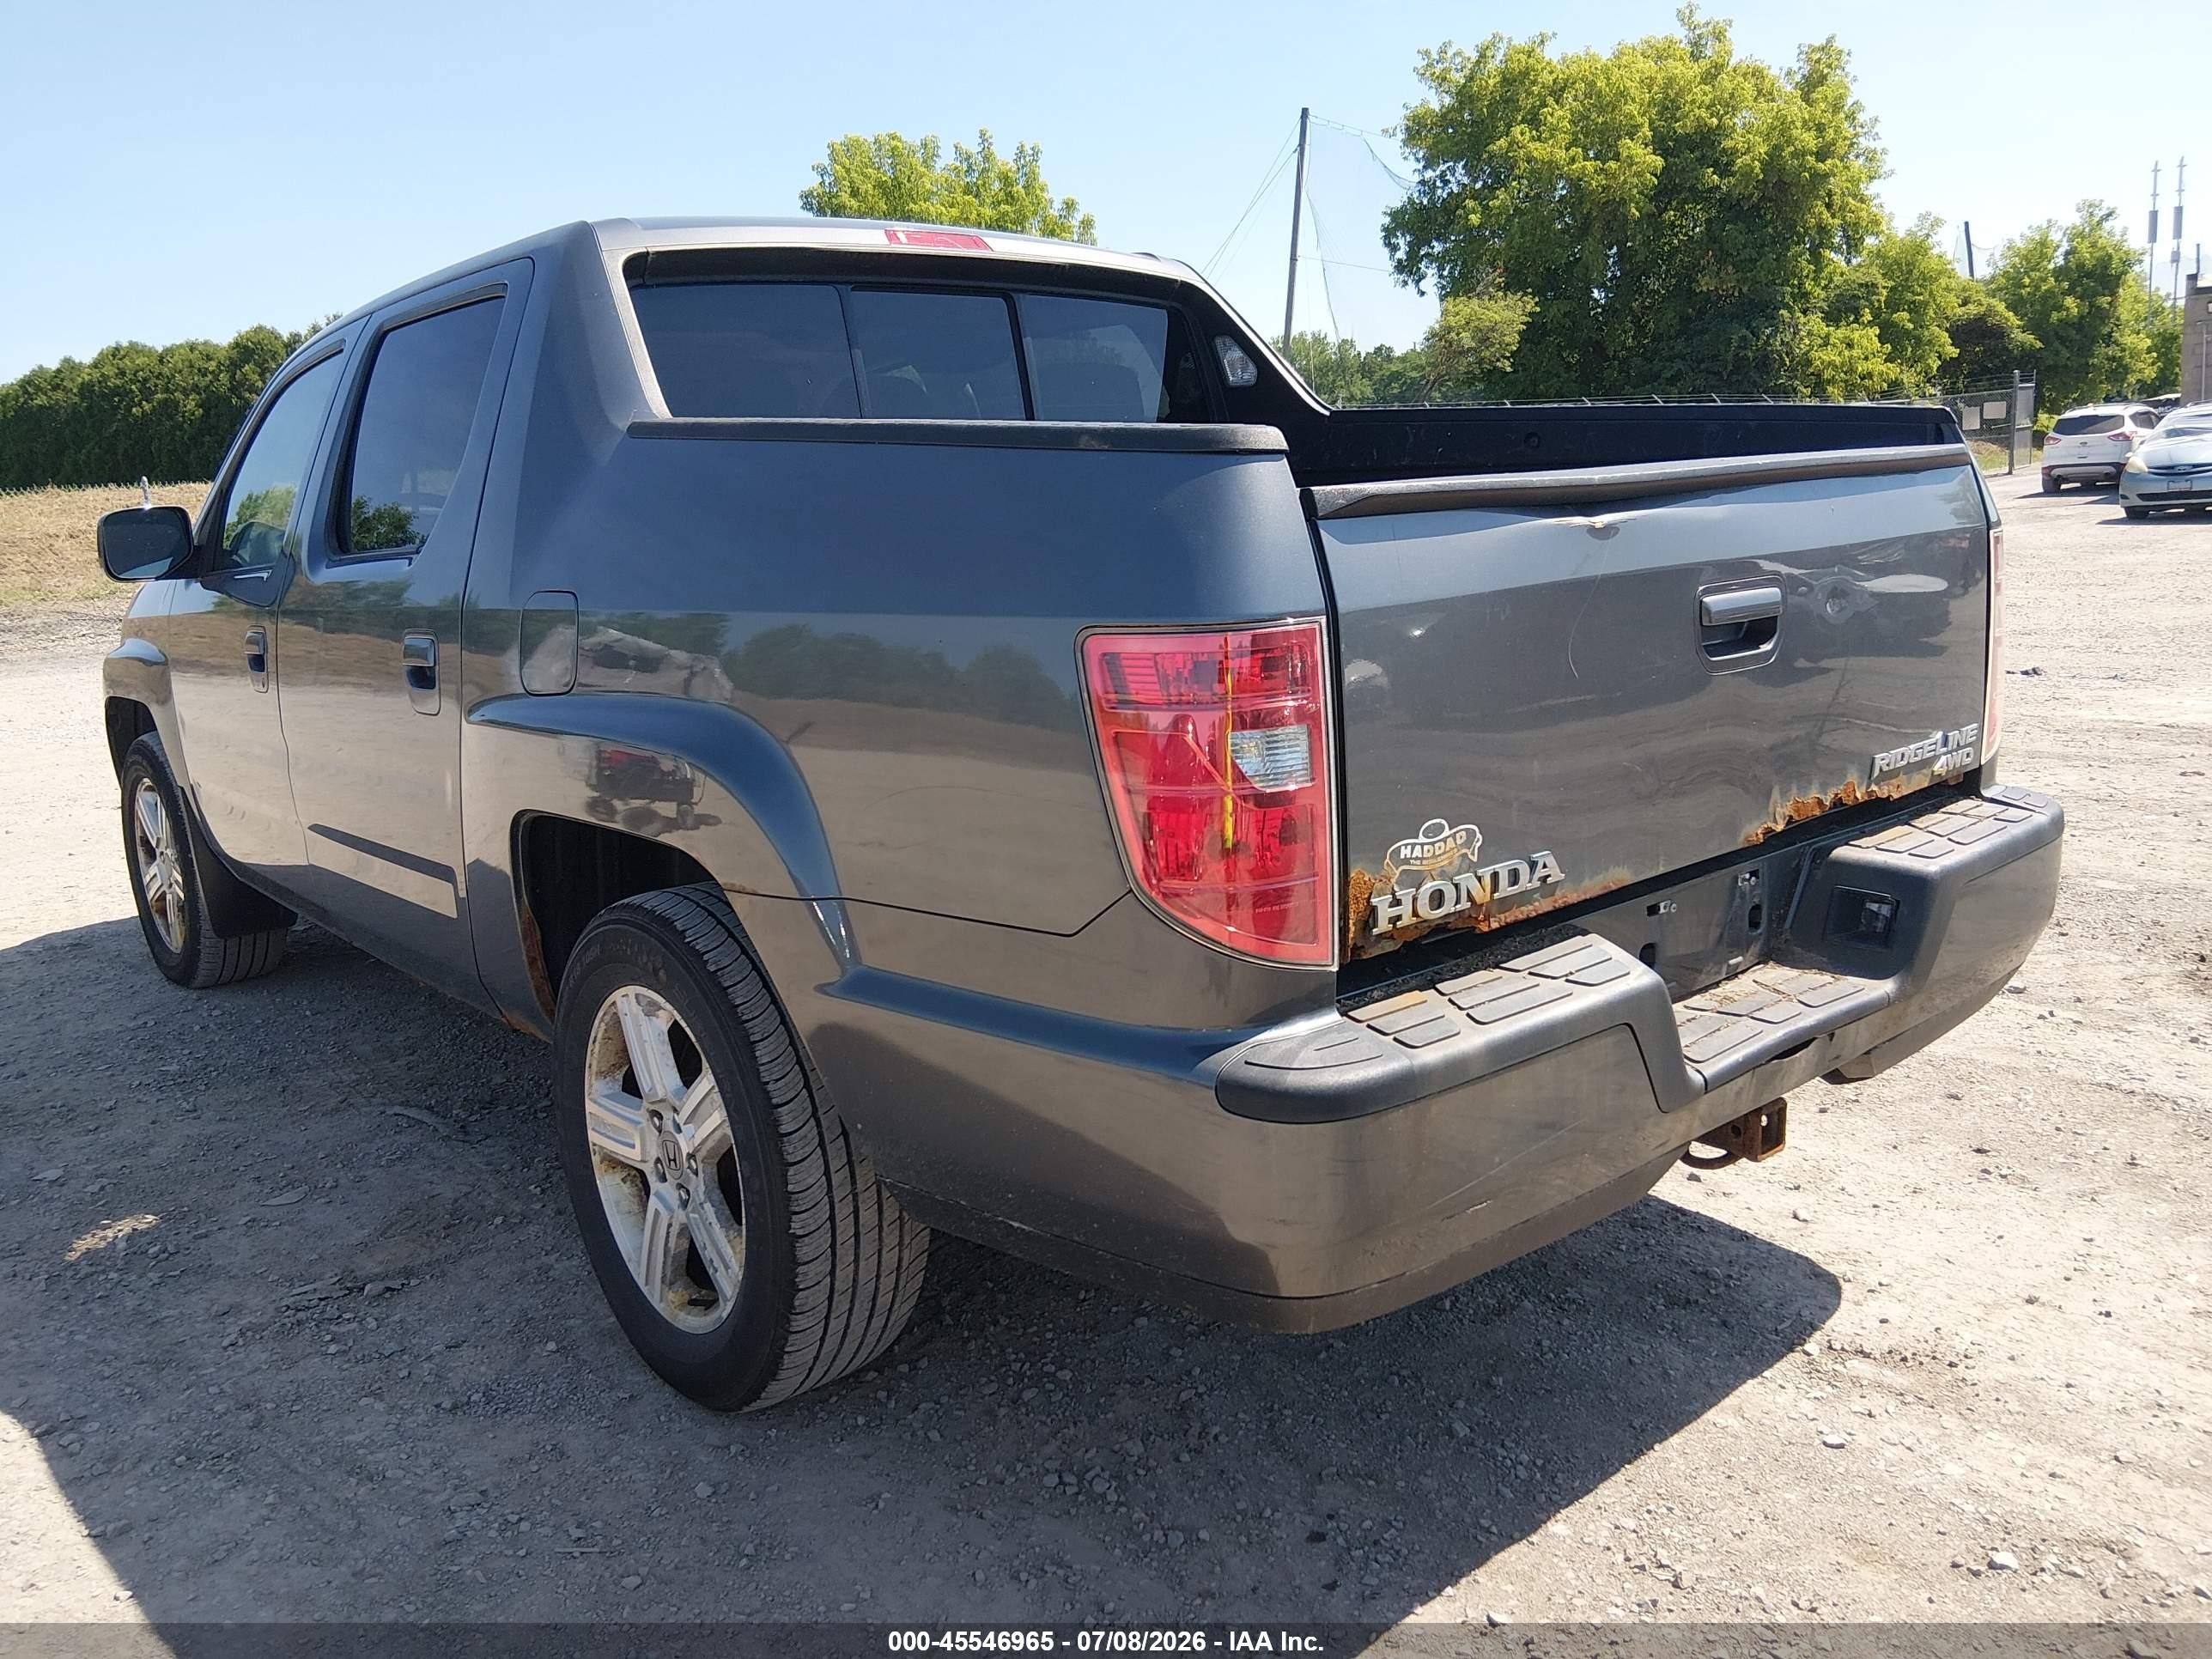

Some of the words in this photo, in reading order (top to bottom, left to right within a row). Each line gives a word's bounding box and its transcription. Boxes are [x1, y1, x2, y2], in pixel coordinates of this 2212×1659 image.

[1869, 723, 1979, 781] RIDGELINE
[1932, 747, 1974, 776] 4WD
[1400, 830, 1467, 859] HADDAD
[1370, 850, 1565, 936] HONDA
